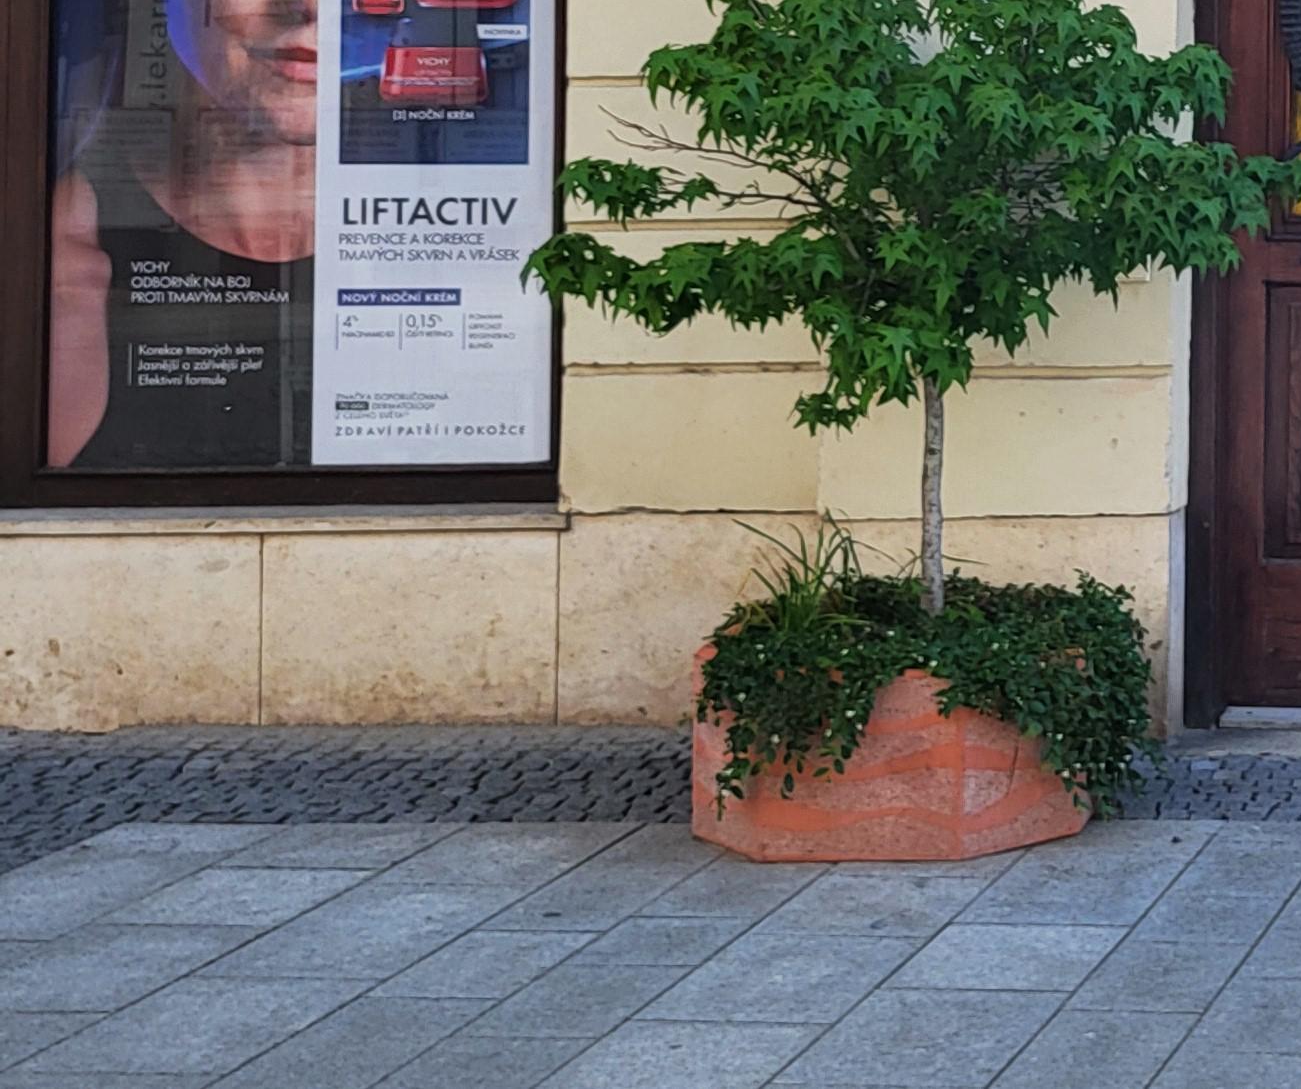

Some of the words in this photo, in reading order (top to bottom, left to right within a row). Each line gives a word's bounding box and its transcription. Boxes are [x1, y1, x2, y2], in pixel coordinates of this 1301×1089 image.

[408, 108, 445, 120] NOČNÍ
[342, 197, 518, 225] LIFTACTIV
[338, 232, 407, 245] PREVENCE
[409, 233, 420, 245] A
[423, 233, 486, 246] KOREKCE
[338, 248, 405, 262] TMAVÝCH
[407, 249, 454, 262] SKVRN
[456, 249, 467, 262] A
[468, 246, 521, 262] VRÁSEK
[130, 260, 171, 273] VICHY
[130, 274, 202, 289] ODBORNÍK
[203, 275, 226, 289] NA
[226, 276, 252, 289] BOJ
[130, 291, 165, 304] PROTI
[167, 289, 223, 304] TMAVÝM
[225, 289, 290, 304] SKVRNÁM
[341, 291, 378, 303] NOVÝ
[380, 291, 422, 303] NOČNÍ
[424, 291, 458, 303] KRÉM
[335, 424, 392, 437] ZDRAVÍ
[397, 422, 440, 437] PATŘÍ
[453, 421, 527, 437] POKOŽCE
